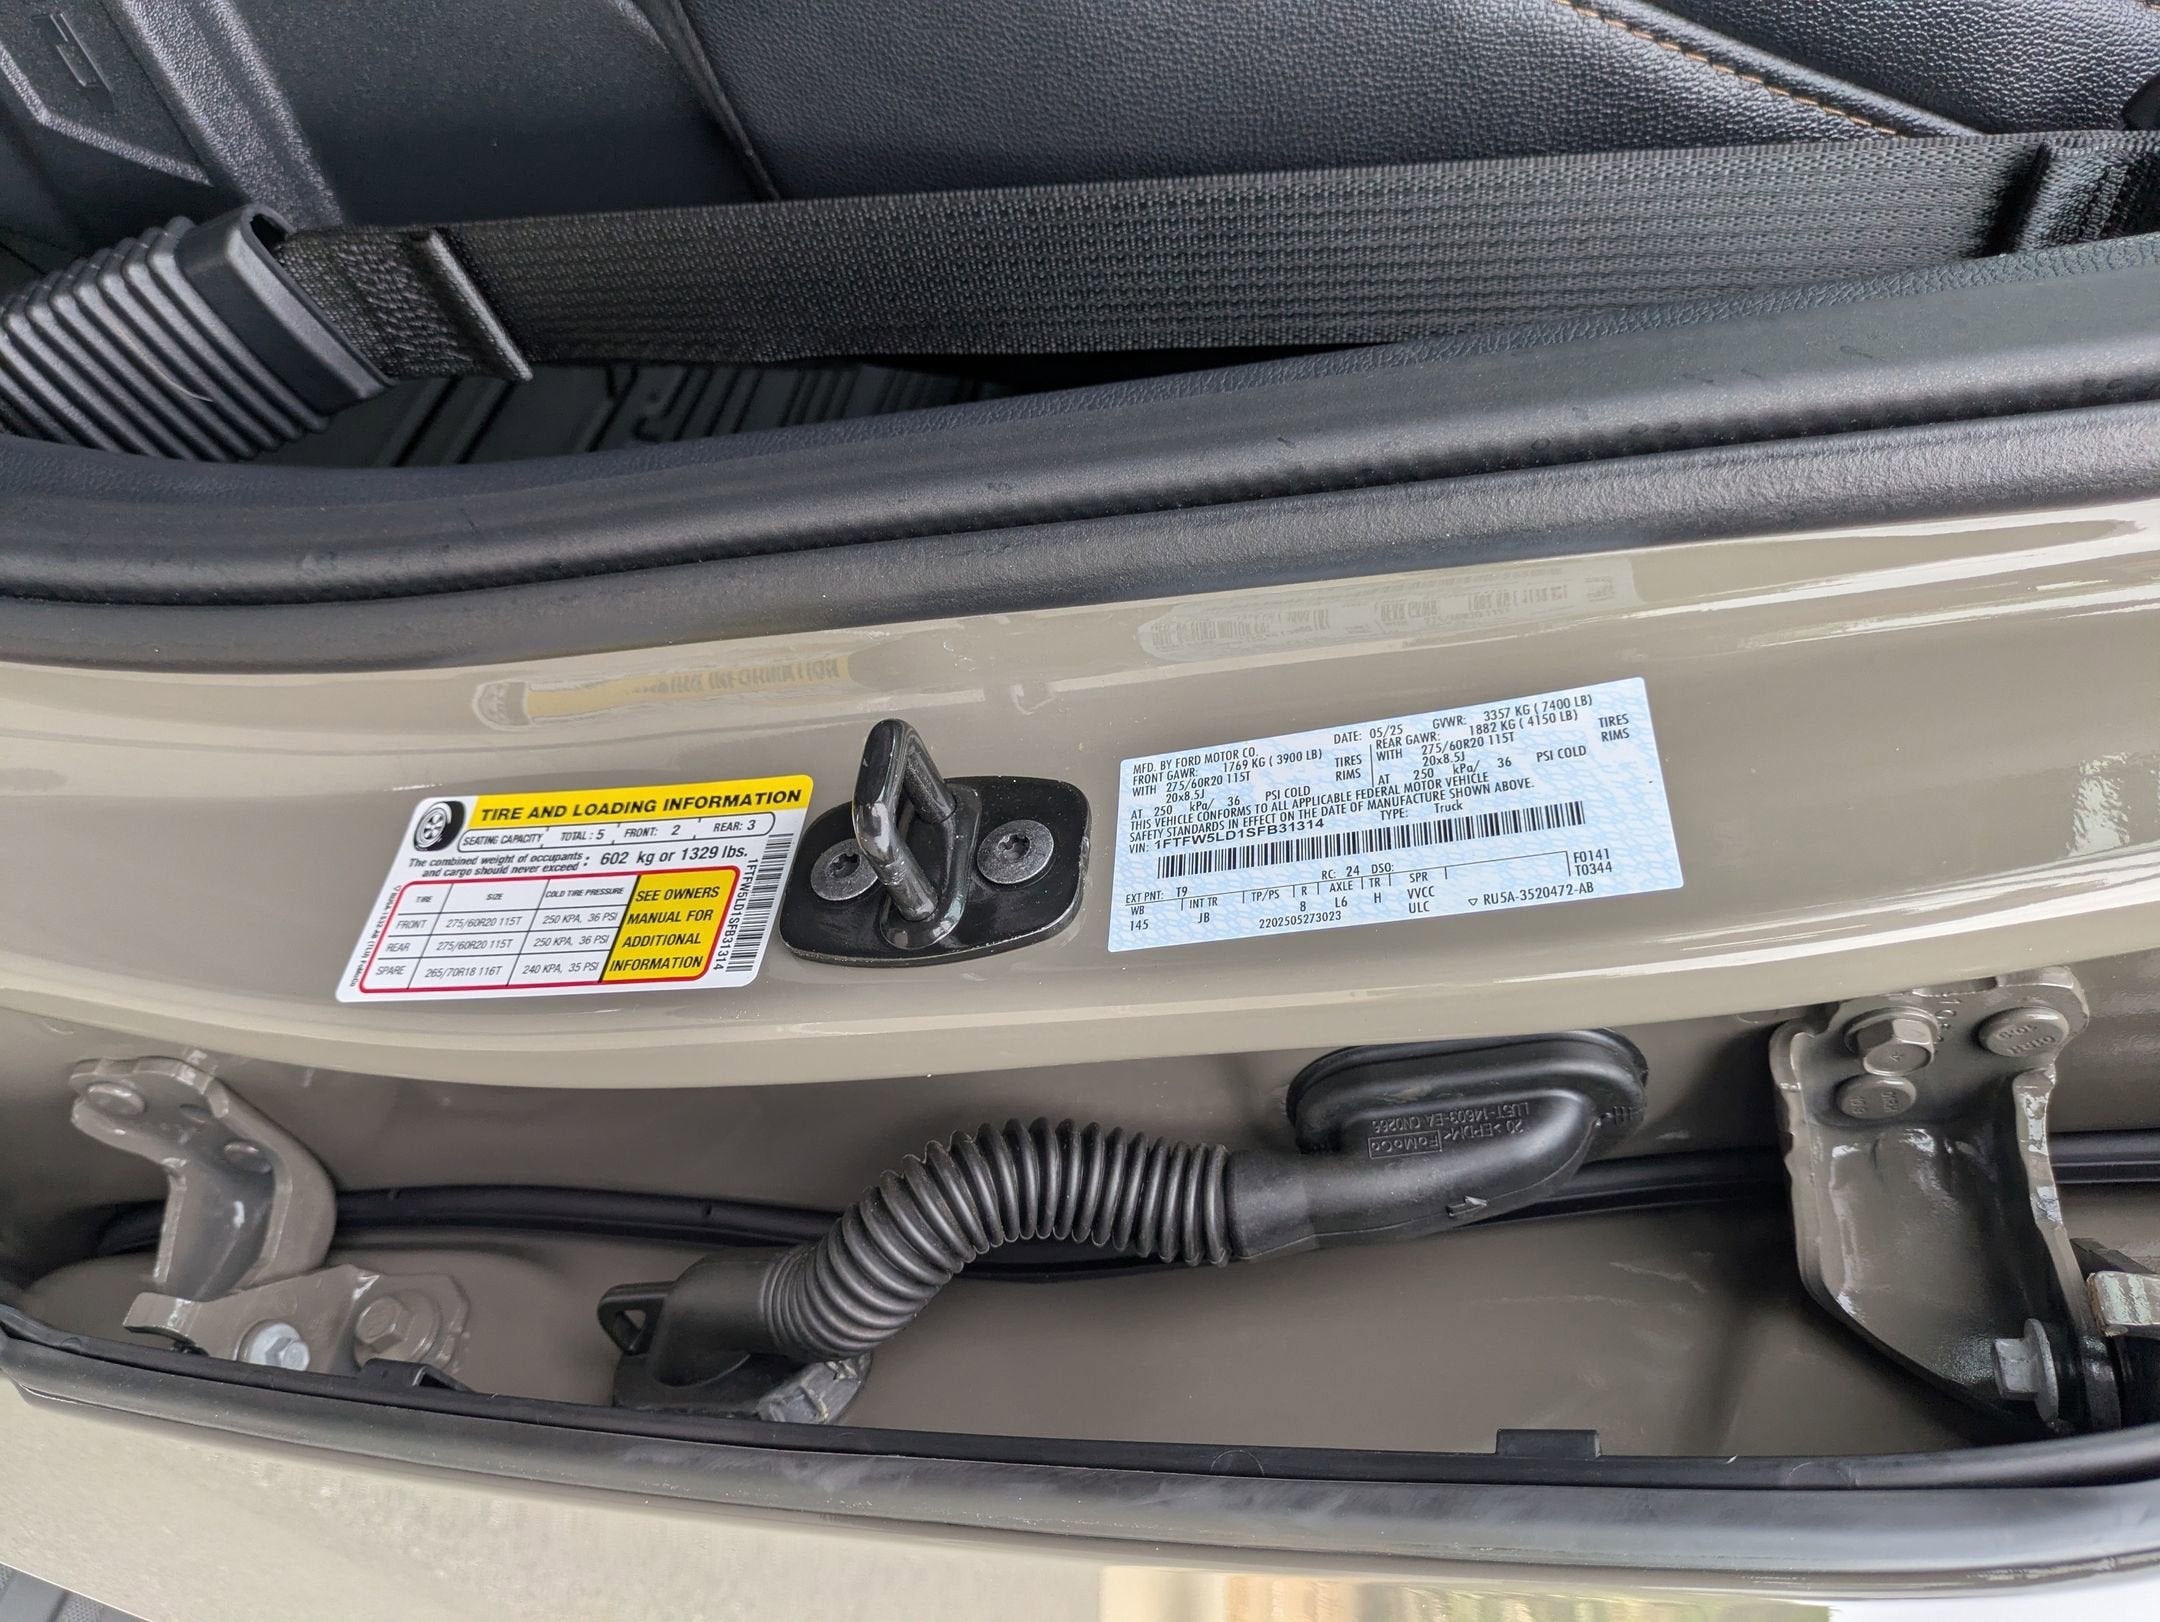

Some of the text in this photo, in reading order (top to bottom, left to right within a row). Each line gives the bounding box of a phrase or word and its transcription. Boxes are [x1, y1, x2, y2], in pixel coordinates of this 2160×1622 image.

[1432, 693, 1593, 730] GVWR: 3357 KG 7400 LB)
[1333, 723, 1403, 745] DATE: 05/25
[1375, 708, 1578, 750] REAR GAWR: 1882 KG 4150 LB)
[1375, 713, 1630, 762] WITH 275/60R20 115T TIRES
[1132, 746, 1259, 777] MFD. BY FORD MOTOR CO.
[1422, 727, 1630, 767] 20x8.5J RIMS
[1132, 748, 1323, 789] FRONT GAWR: 1769 KG 3900 LB)
[1132, 753, 1363, 797] WITH 275/60R20 115T TIRES
[1165, 767, 1362, 804] 20x8.5J RIMS
[481, 789, 802, 822] TIRE AND LOADING INFORMATION
[1129, 777, 1535, 843] SAFETY STANDARDS IN EFFECT ON THE DATE OF MANUFACTURE SHOWN ABOVE.
[1130, 771, 1489, 832] THIS VEHICLE CONFORMS TO ALL APPLICABLE FEDERAL MOTOR VEHICLE
[1130, 785, 1311, 820] AT 250 kPa/ 36 PSI COLD
[1379, 799, 1463, 821] TYPE: Truck
[462, 835, 500, 846] SEATING
[500, 833, 544, 845] CAPACITY
[595, 828, 606, 841] 5
[623, 826, 658, 838] FRONT:
[671, 824, 681, 836] 2
[712, 821, 744, 833] REAR:
[746, 819, 757, 831] 3
[1128, 817, 1325, 854] VIN: 1FTFW5LD1SFB31314
[409, 851, 584, 868] The combined weight of occupants
[421, 861, 580, 879] and cargo should never exceed
[600, 845, 748, 866] 602 kg or 1329 lbs.
[1321, 862, 1394, 880] RC: 24 DSO:
[416, 887, 624, 903] TIRE SIZE COLD TIRE PRESSURE
[635, 885, 721, 903] SEE OWNERS
[1125, 886, 1188, 904] EXT PNT: T9
[1130, 848, 1610, 916] WB INT TR TP/PS AXLE TR SPR F0141
[1130, 860, 1613, 932] 145 JB L6 H VVCC T0344
[396, 911, 619, 929] FRONT 275/60R20 115T 250 KPA, 36 PSI
[626, 909, 714, 925] MANUAL FOR
[712, 858, 759, 971] 1FTFW5LD1SFB31314
[1258, 881, 1594, 929] 2202505273023 ULC RU5A-3520472-AB
[621, 932, 702, 948] ADDITIONAL
[375, 961, 600, 979] SPARE 265/70R18 116T 240 KPA, 35 PSI
[609, 955, 704, 972] INFORMATION
[1371, 1134, 1439, 1153] FoMoCo
